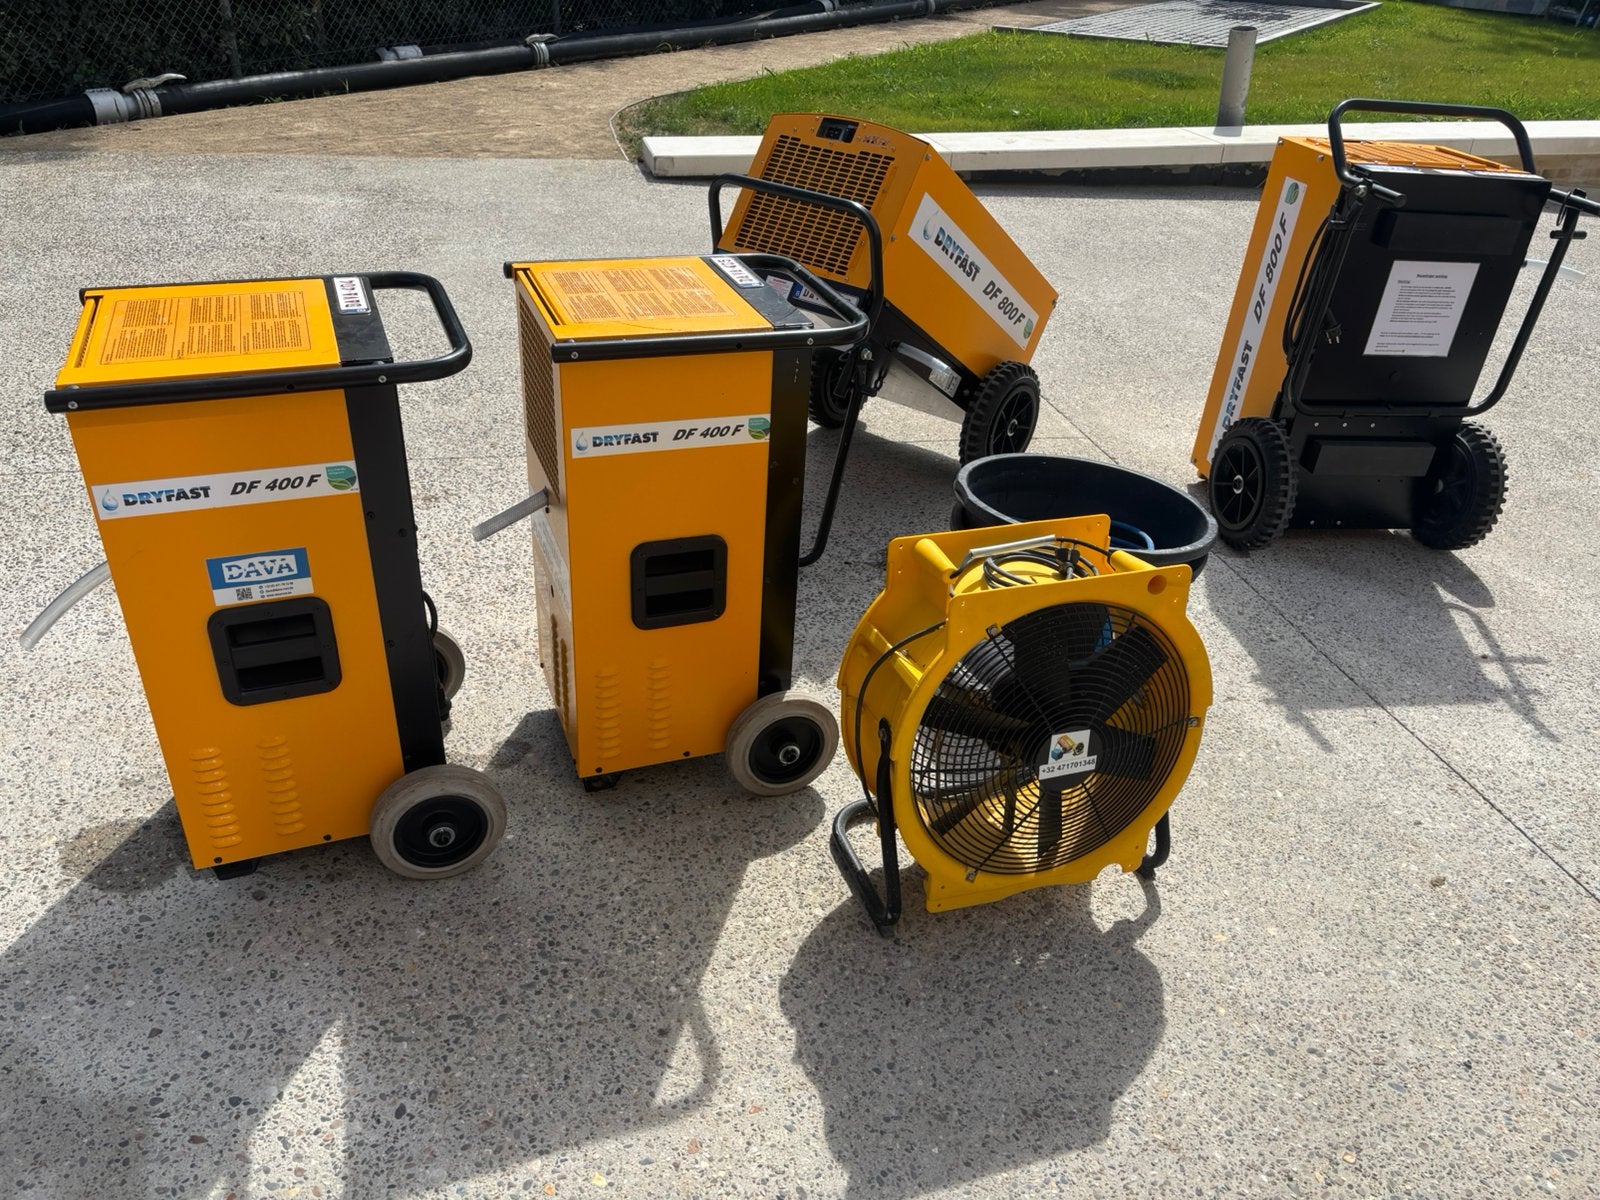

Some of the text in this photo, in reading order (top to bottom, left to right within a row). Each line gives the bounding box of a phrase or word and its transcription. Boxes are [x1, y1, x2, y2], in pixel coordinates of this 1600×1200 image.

[934, 226, 1026, 326] DRYFAST DF 800 F
[1222, 211, 1287, 431] DRYFAST DF 800 F
[592, 424, 745, 447] DRYFAST DF 400 F
[123, 474, 322, 506] DRYFAST DF 400 F
[224, 558, 295, 581] DAVA
[1041, 765, 1055, 774] +32
